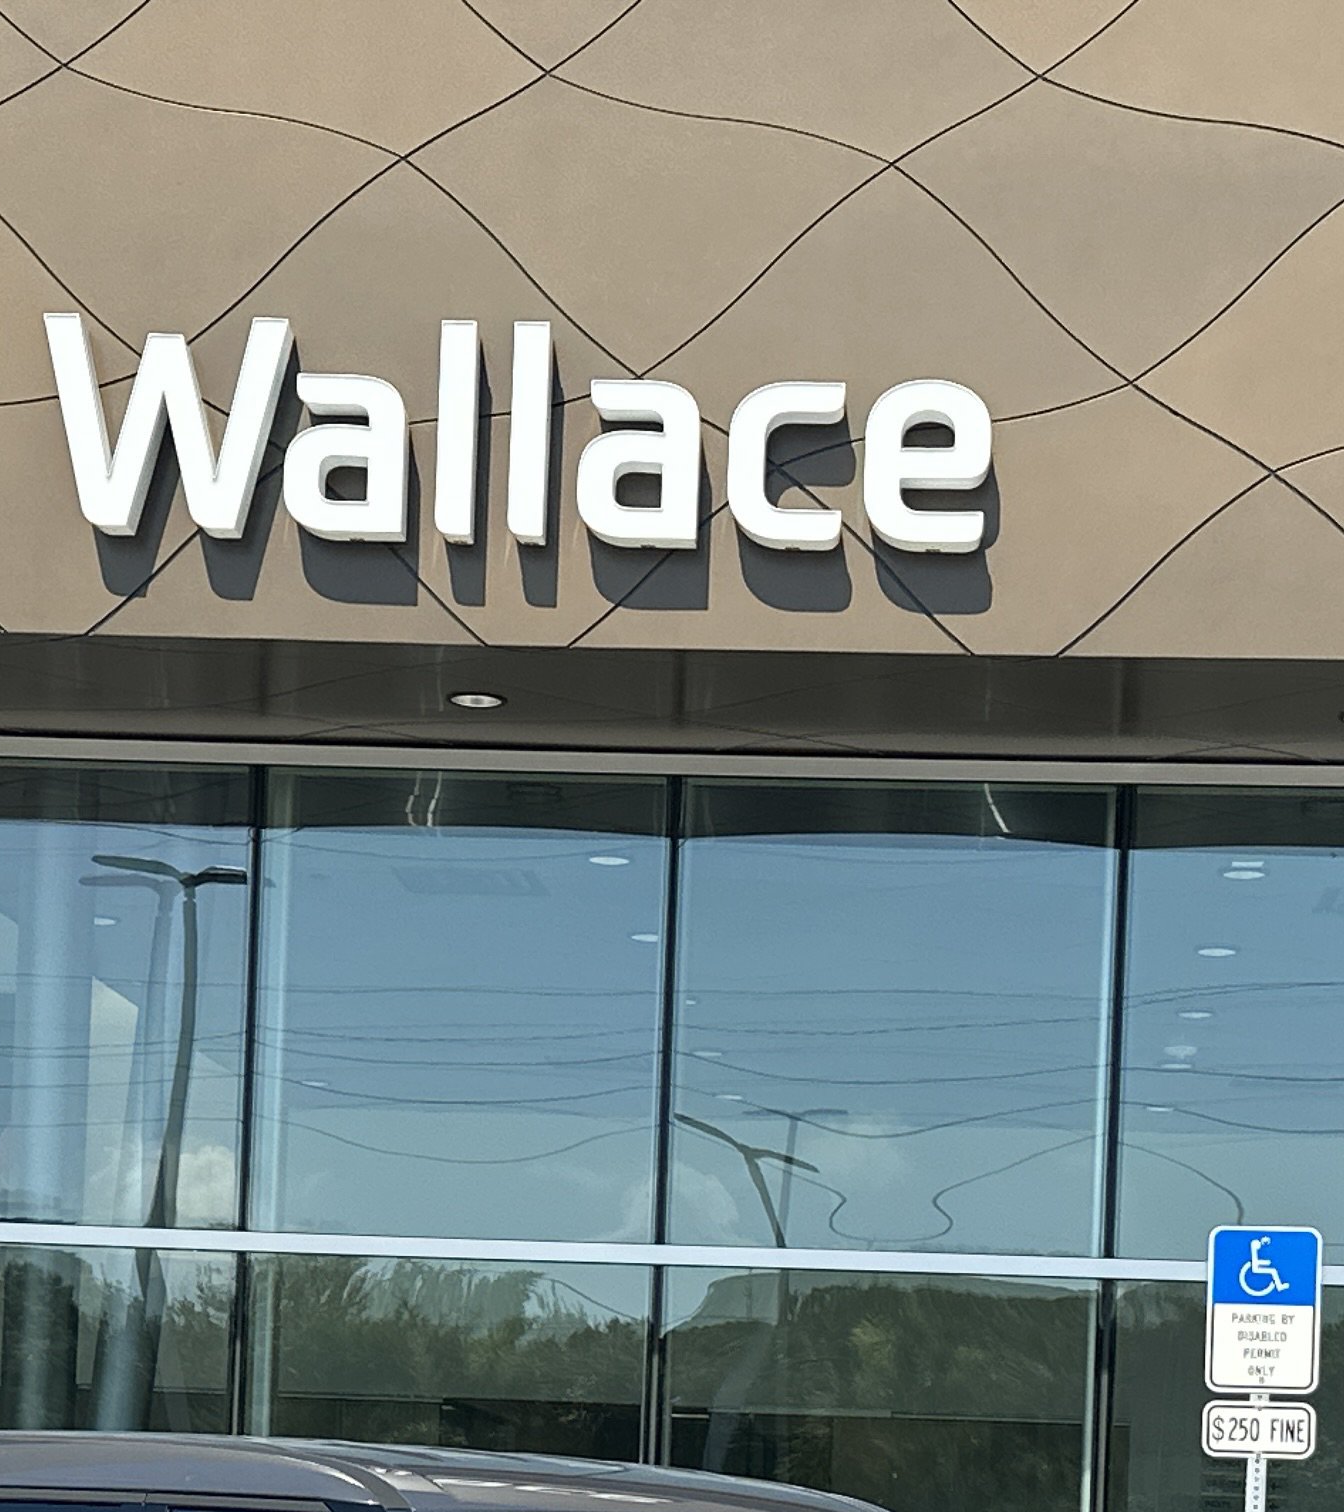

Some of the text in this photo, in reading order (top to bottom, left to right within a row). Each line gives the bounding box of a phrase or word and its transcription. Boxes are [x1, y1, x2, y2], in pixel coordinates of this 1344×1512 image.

[43, 313, 993, 553] Wallace
[1231, 1313, 1295, 1325] PARKING BY
[1237, 1331, 1287, 1342] DISABLED
[1243, 1348, 1280, 1359] PERMIT
[1248, 1366, 1275, 1377] ONLY
[1212, 1415, 1305, 1443] $250 FINE
